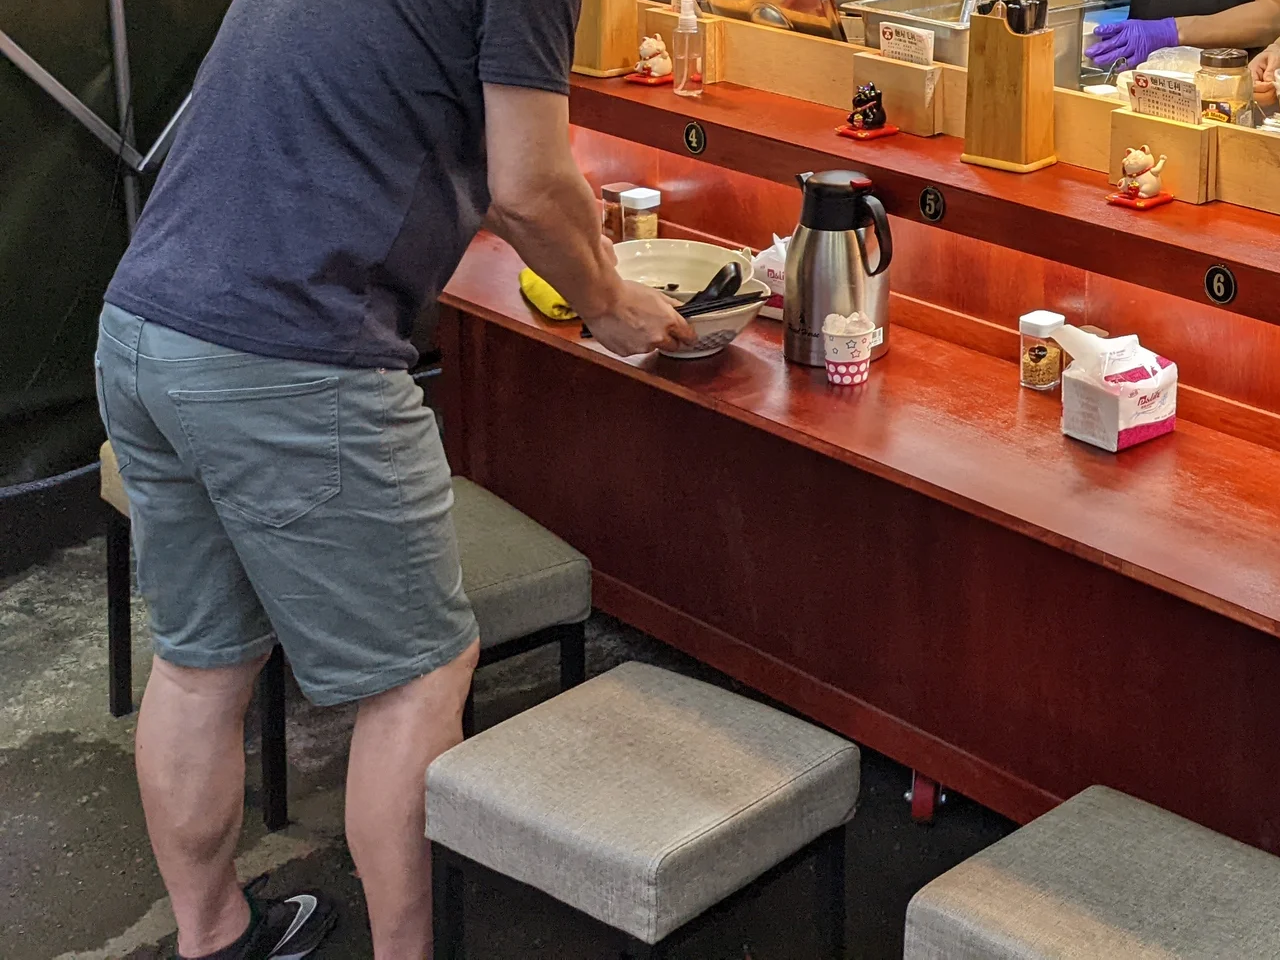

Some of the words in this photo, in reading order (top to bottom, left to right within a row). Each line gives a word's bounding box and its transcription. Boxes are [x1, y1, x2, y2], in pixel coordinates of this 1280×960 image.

[688, 128, 698, 147] 4
[925, 193, 935, 215] 5
[1213, 273, 1225, 297] 6
